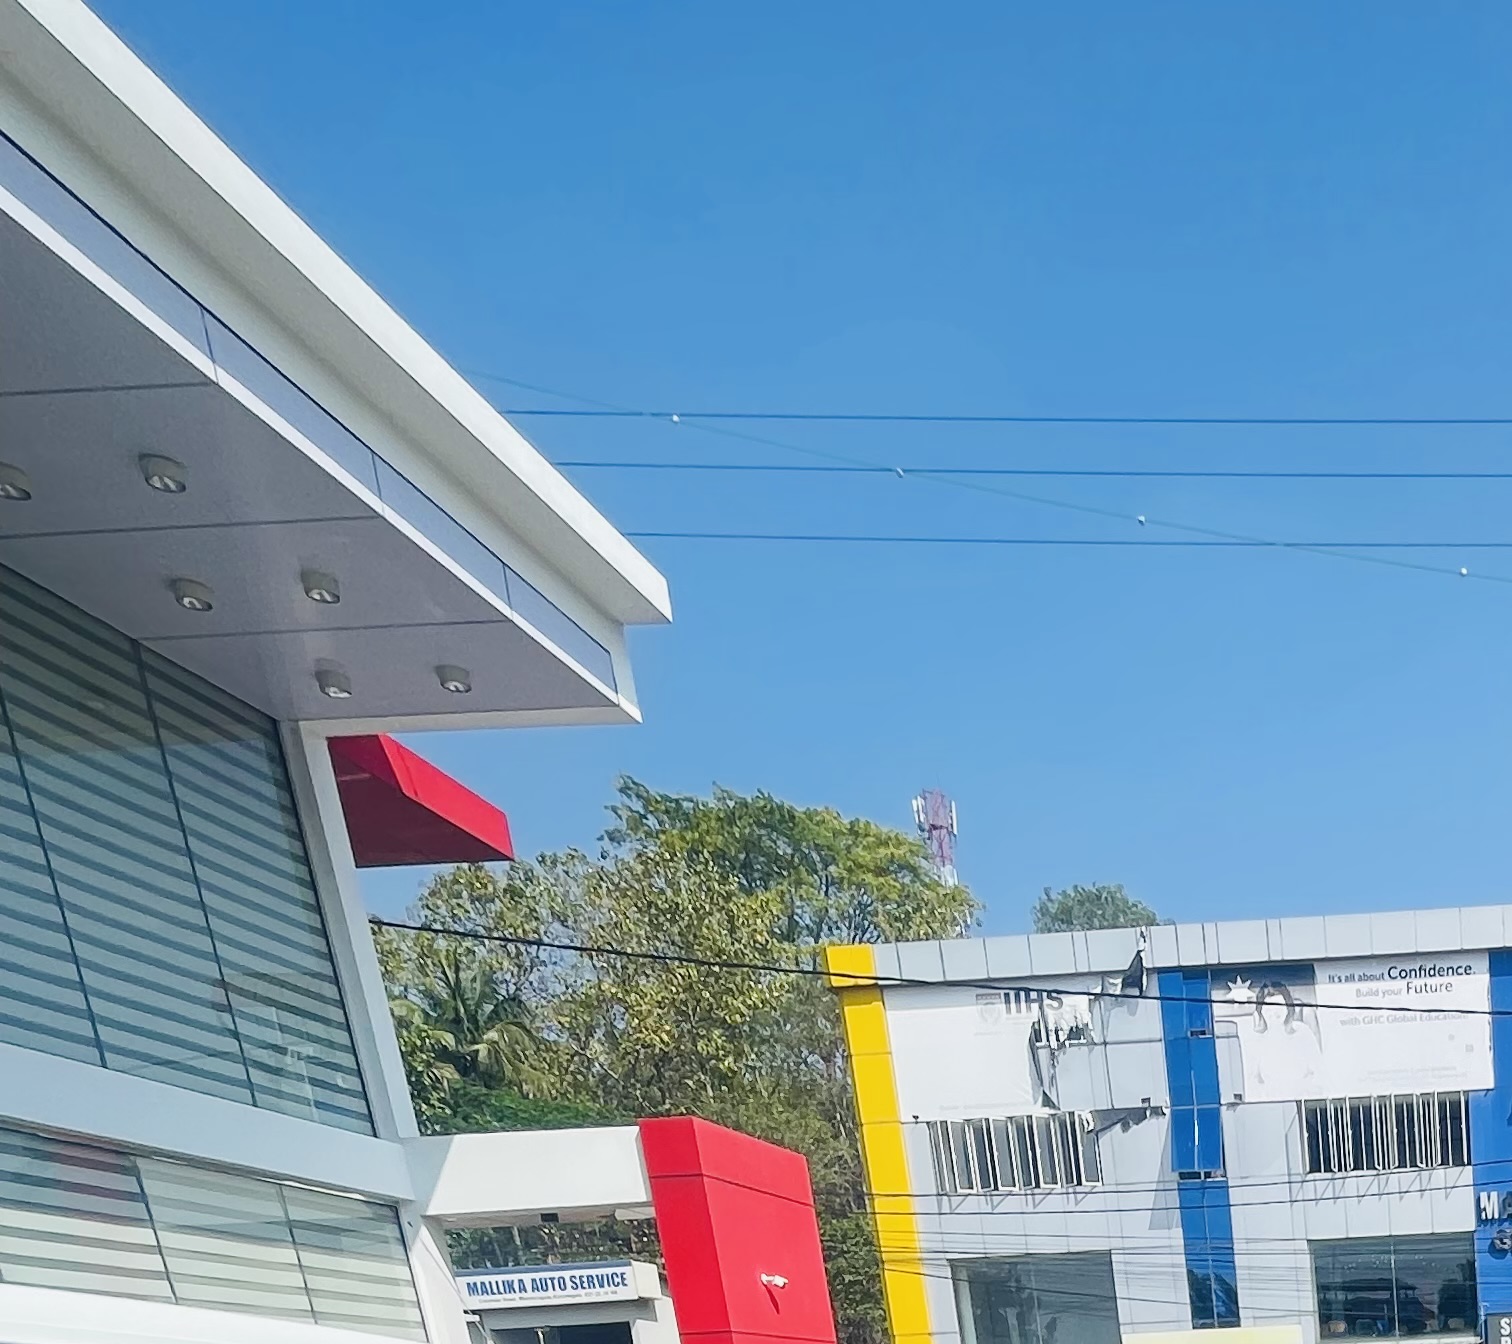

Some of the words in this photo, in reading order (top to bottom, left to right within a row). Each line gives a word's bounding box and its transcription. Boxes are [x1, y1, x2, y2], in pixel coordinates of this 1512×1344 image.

[1344, 973, 1355, 982] all
[1358, 972, 1385, 982] about
[1355, 986, 1379, 998] Build
[1381, 986, 1403, 999] your
[1406, 981, 1453, 995] Future
[1340, 1016, 1361, 1026] with
[1386, 1014, 1417, 1024] Global
[466, 1278, 528, 1297] MALLIKA
[530, 1275, 568, 1293] AUTO
[570, 1271, 629, 1292] SERVICE
